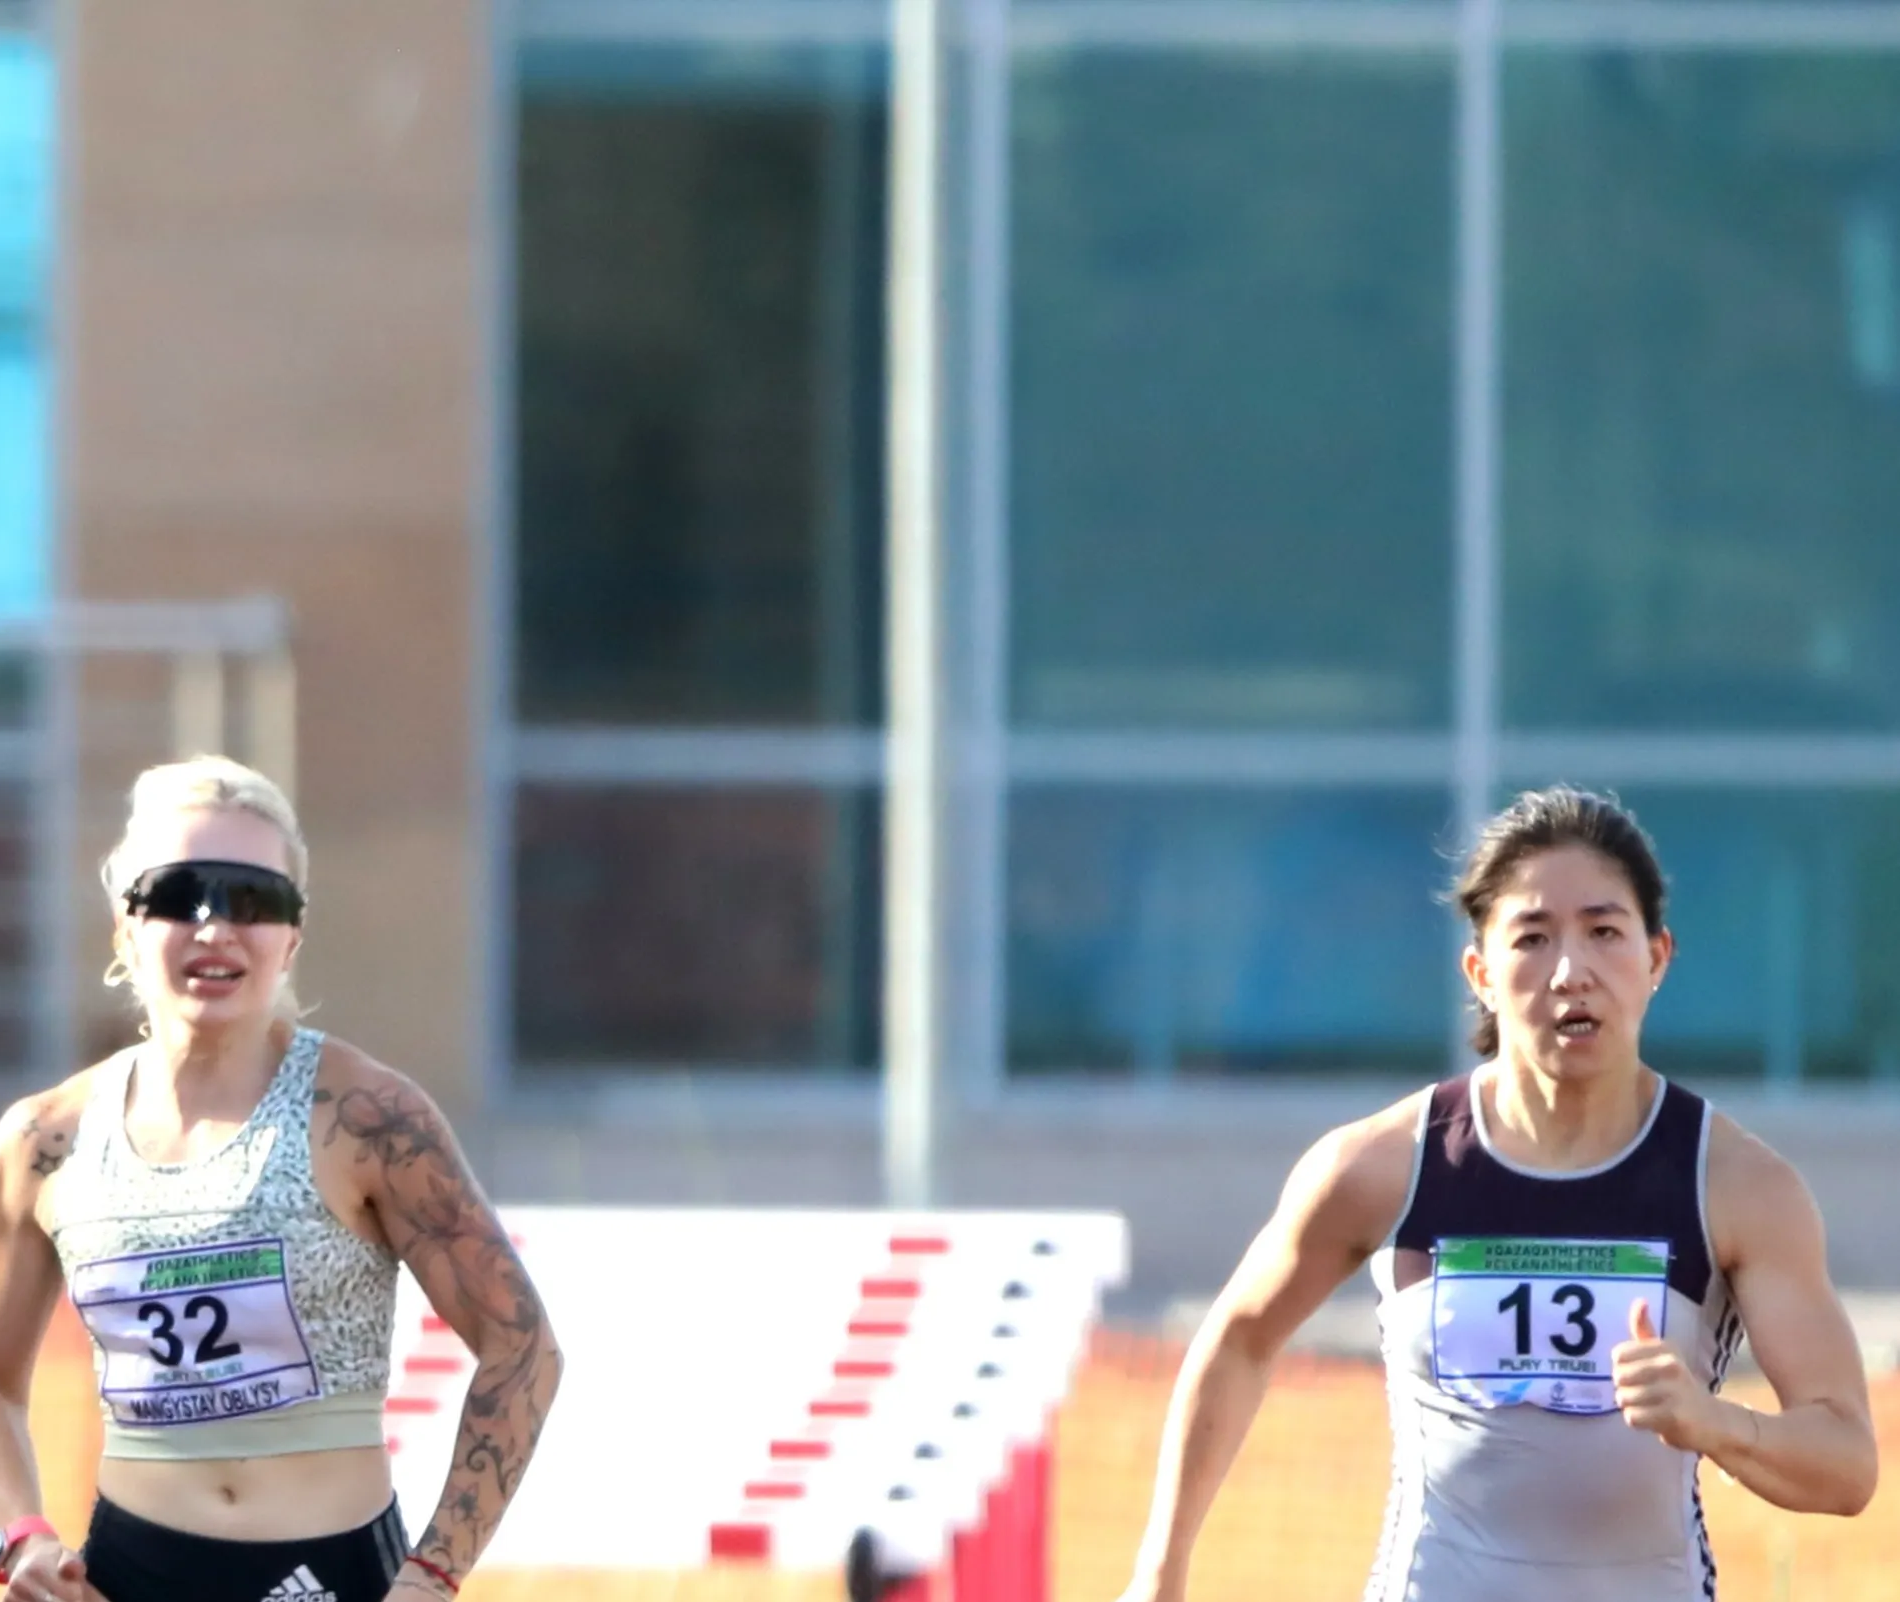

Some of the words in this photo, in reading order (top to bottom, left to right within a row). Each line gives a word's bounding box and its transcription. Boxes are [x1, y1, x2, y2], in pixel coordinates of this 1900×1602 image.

[137, 1295, 243, 1367] 32
[1497, 1282, 1598, 1357] 13
[220, 1379, 280, 1412] OBLYSY
